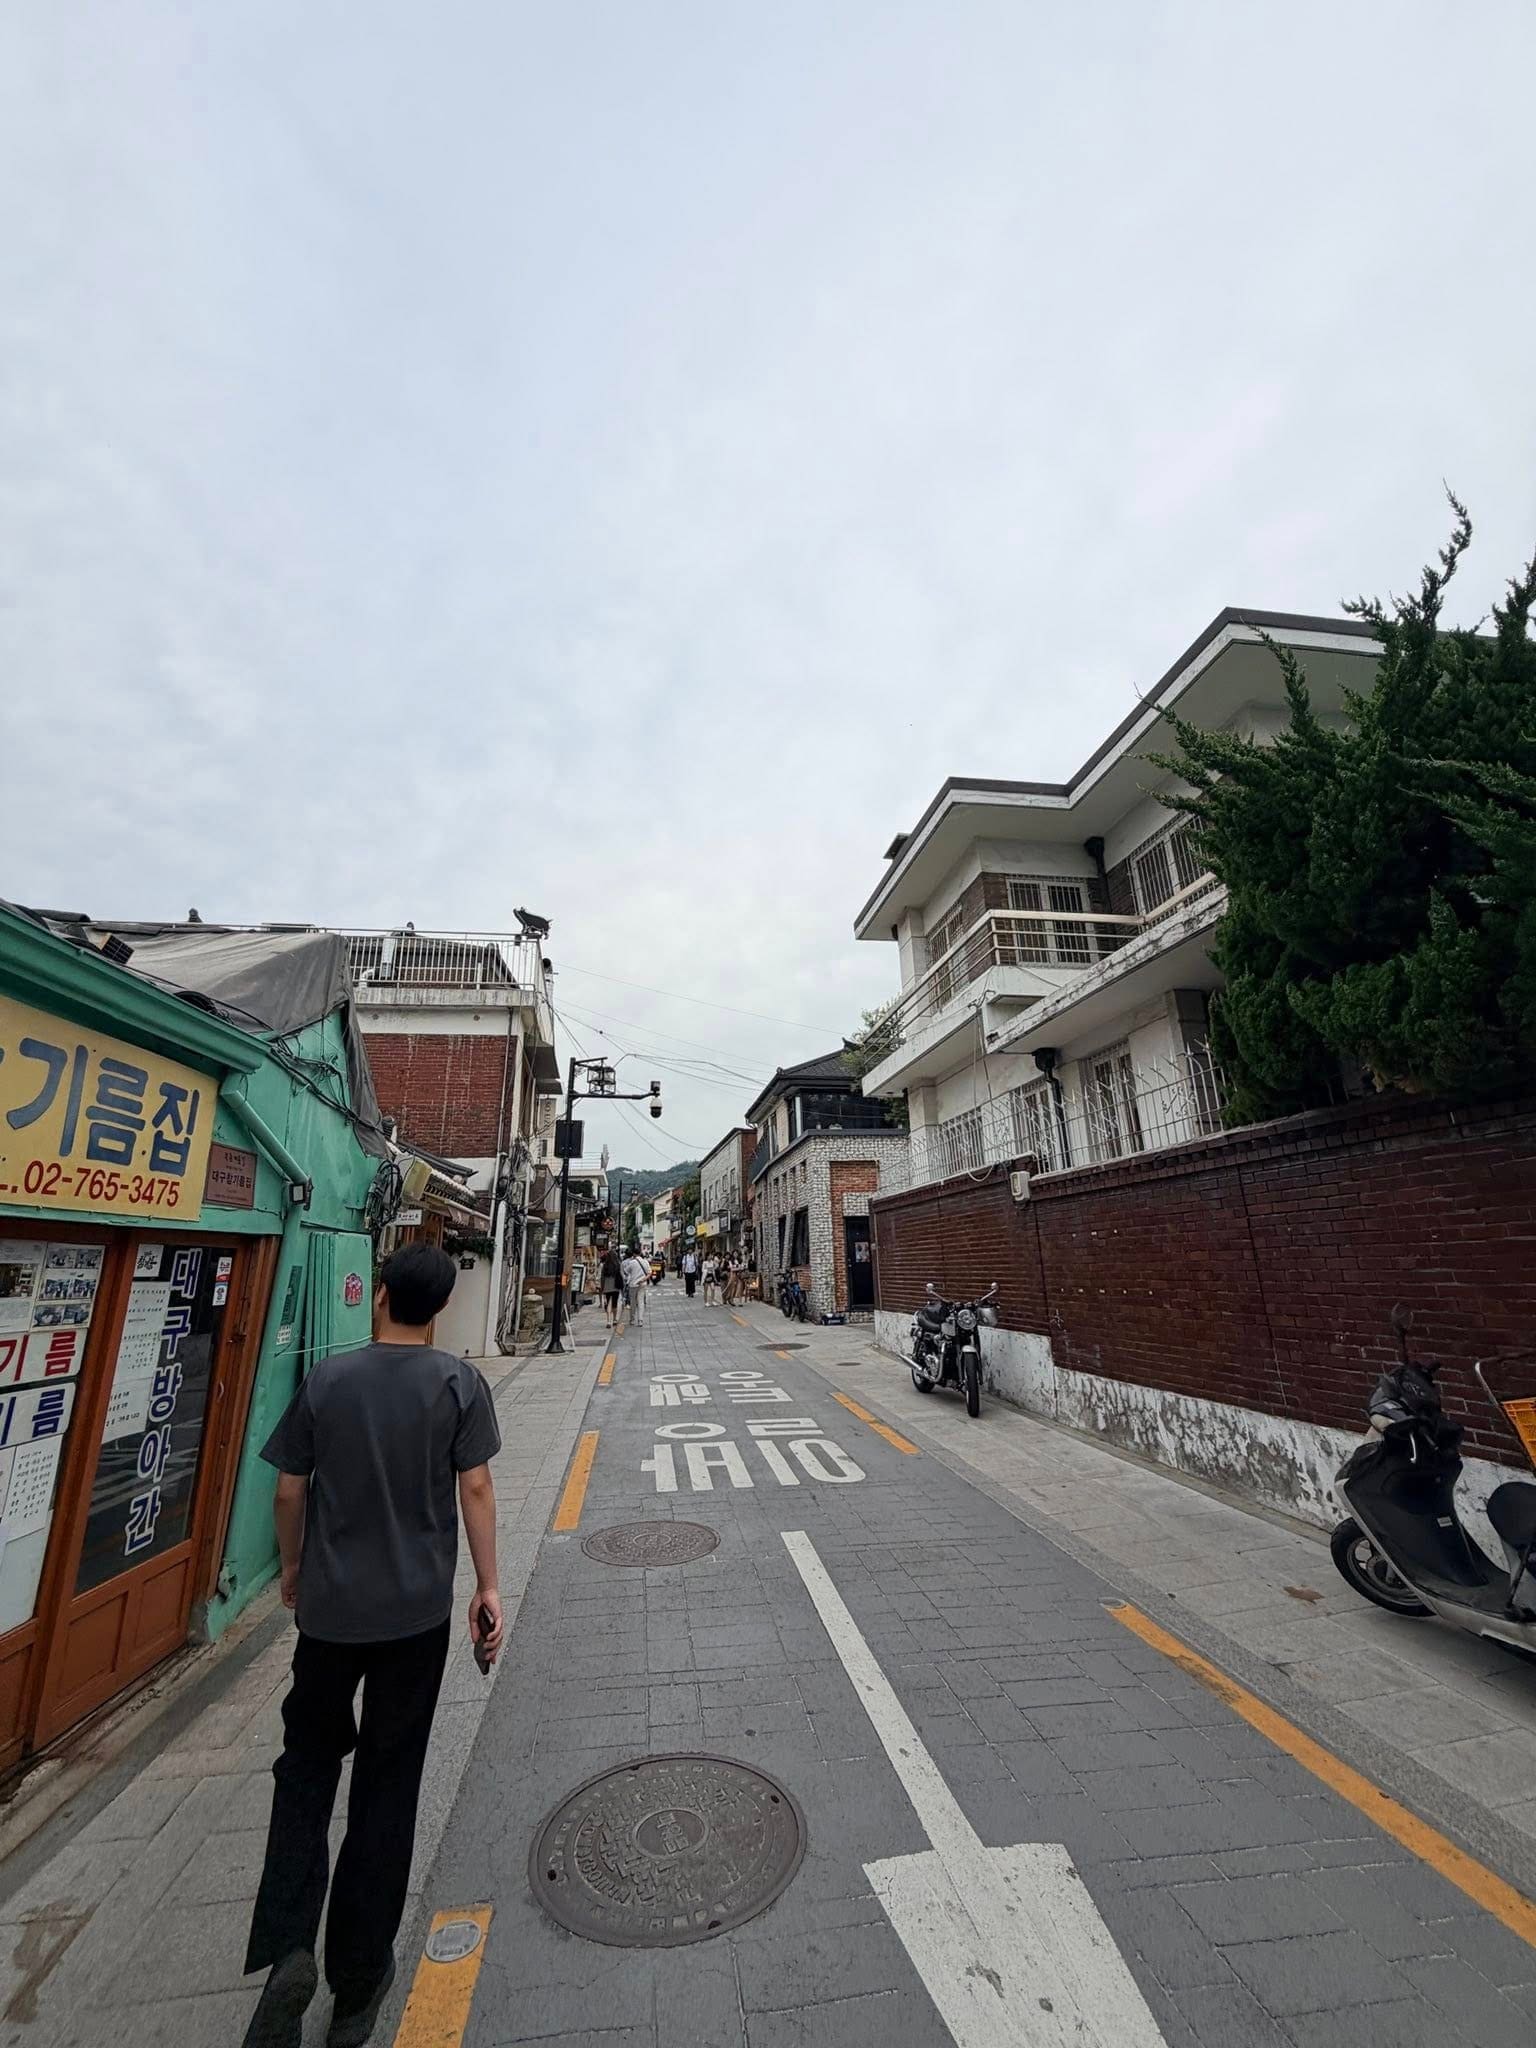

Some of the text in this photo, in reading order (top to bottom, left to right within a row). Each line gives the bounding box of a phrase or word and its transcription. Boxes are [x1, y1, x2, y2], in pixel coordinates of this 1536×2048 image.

[0, 1037, 200, 1177] 기름집
[24, 1160, 180, 1207] 02-765-3475
[124, 1247, 204, 1556] 대구방아간
[649, 1370, 793, 1407] 통행
[640, 1417, 867, 1493] 일방
